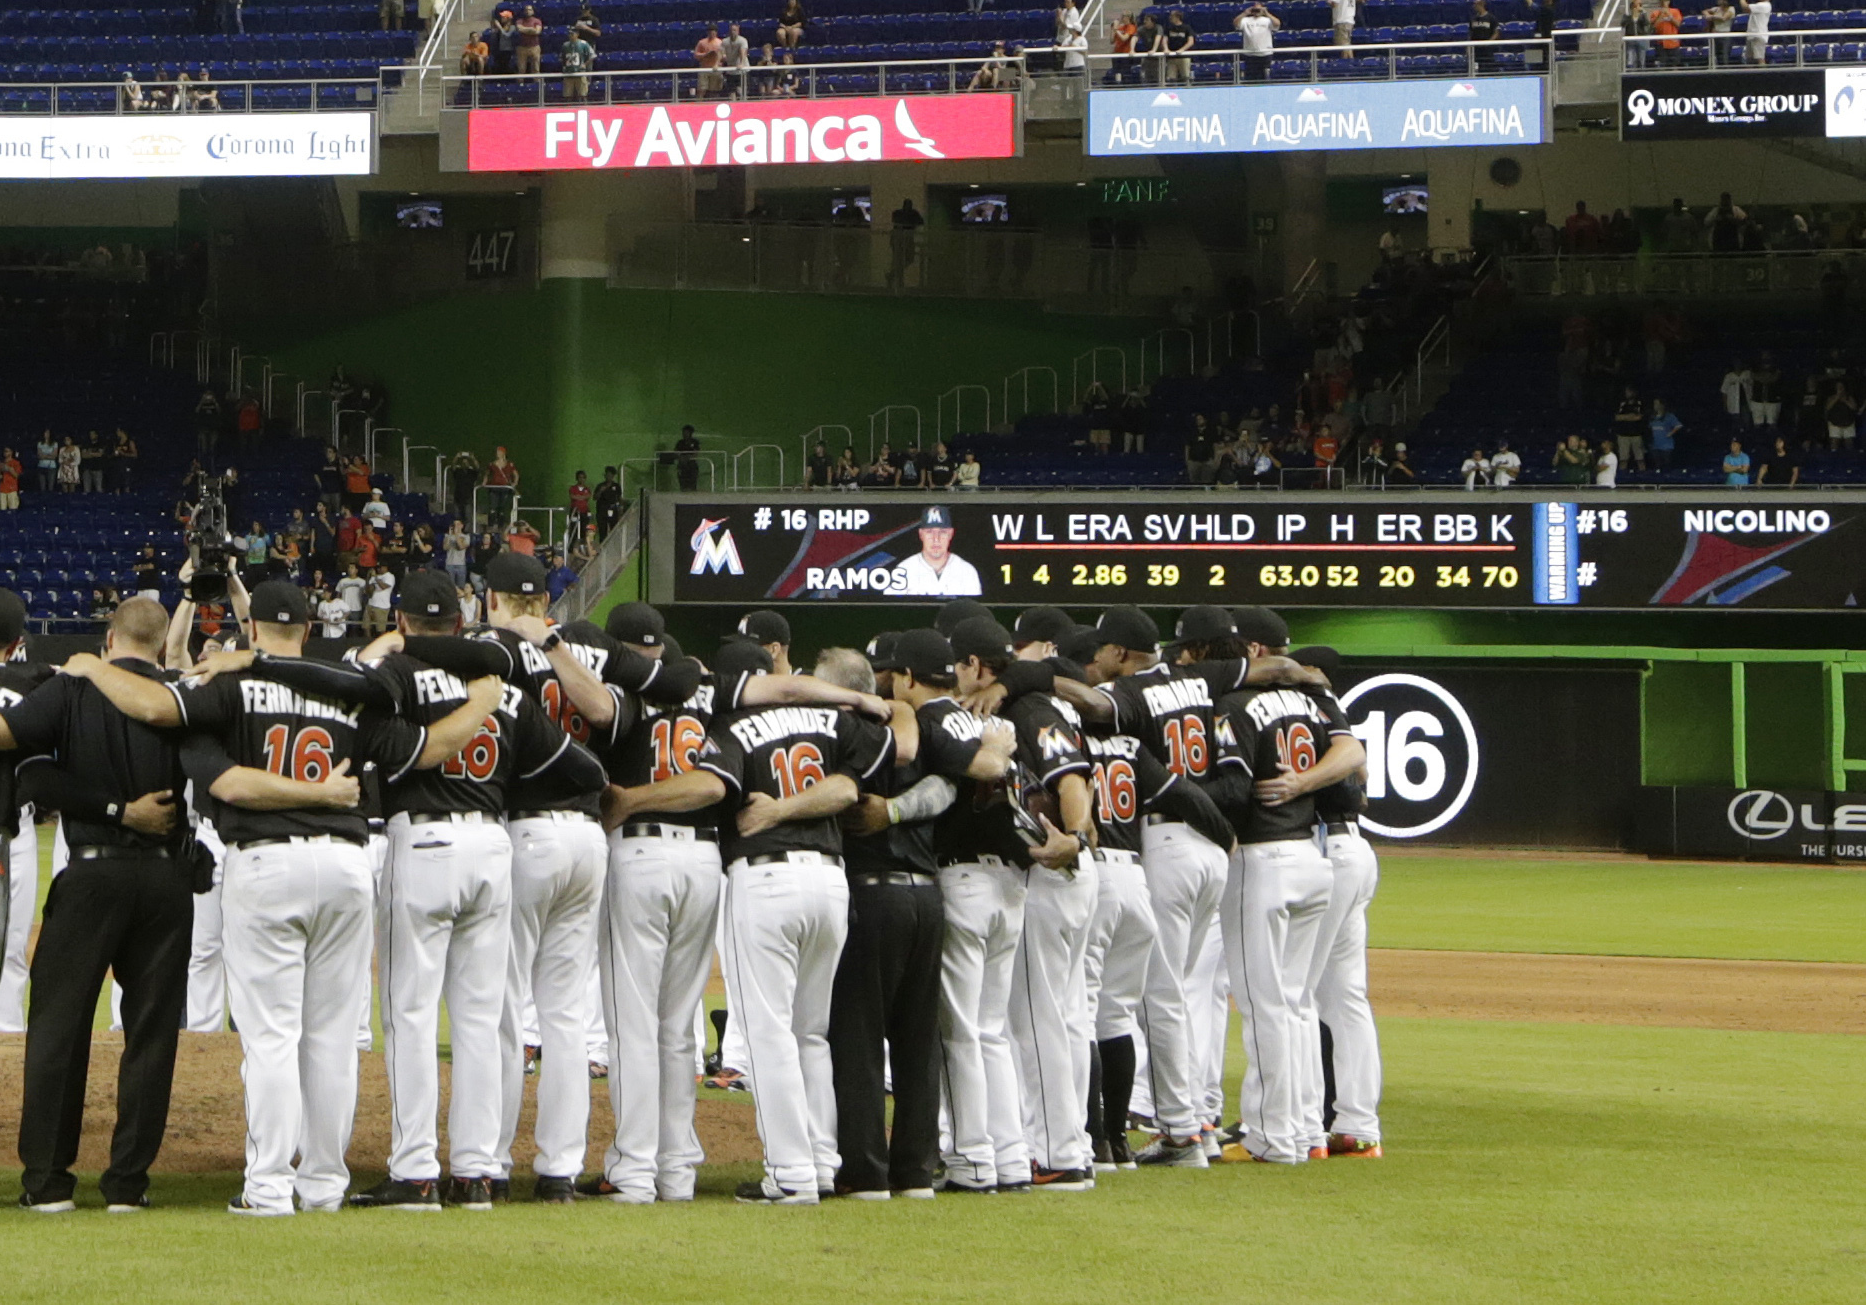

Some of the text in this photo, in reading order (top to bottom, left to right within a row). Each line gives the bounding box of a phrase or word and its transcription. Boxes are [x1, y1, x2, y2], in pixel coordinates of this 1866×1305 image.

[1401, 104, 1524, 142] AQUAFINA
[1657, 93, 1819, 116] MONEX GROUP
[205, 130, 366, 162] Corona Light
[544, 102, 883, 169] Fly Avianca
[1108, 113, 1226, 149] AQUAFINA
[1252, 109, 1373, 146] AQUAFINA
[40, 135, 111, 162] Extra
[469, 231, 515, 272] 447
[753, 507, 871, 531] # 16 RHP
[991, 514, 1514, 543] W L ERA SV HLD IP H ER BB K
[1575, 508, 1831, 534] #16 NICOLINO
[1547, 501, 1567, 601] WARMING UP
[805, 566, 909, 591] RAMOS
[999, 563, 1519, 588] 1 4 2.86 39 2 63.0 52 20 34 70
[1576, 561, 1598, 587] #
[729, 705, 839, 754] FERNANDEZ
[1163, 713, 1208, 778] 16
[1276, 721, 1318, 775] 16
[263, 723, 334, 783] 16
[650, 715, 706, 785] 16
[1350, 709, 1446, 802] 16
[769, 740, 826, 800] 16
[1092, 758, 1137, 825] 16
[1801, 844, 1866, 857] THE URS
